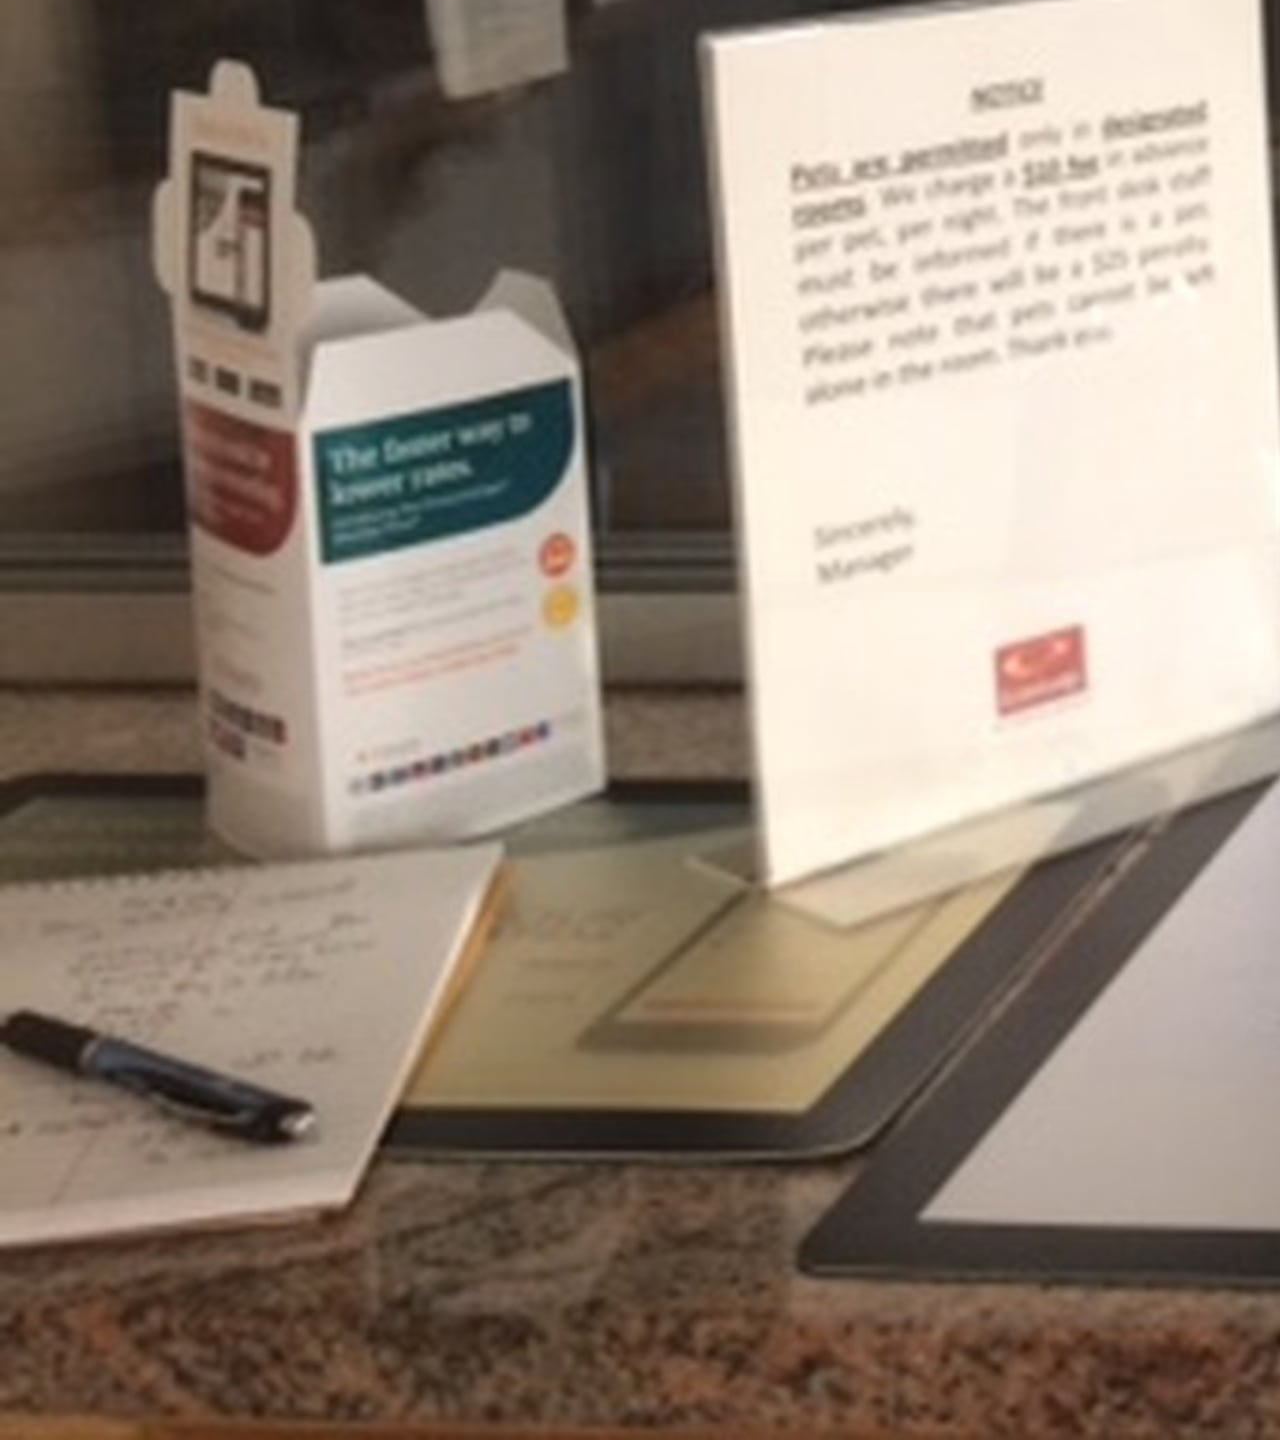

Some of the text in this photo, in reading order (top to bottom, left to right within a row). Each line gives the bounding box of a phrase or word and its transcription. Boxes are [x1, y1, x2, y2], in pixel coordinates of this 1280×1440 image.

[970, 77, 1045, 113] NOTICE
[790, 161, 840, 193] Pets
[852, 154, 889, 182] are
[898, 130, 1010, 175] permitted
[1018, 124, 1062, 150] only
[1100, 97, 1208, 140] designated
[880, 185, 916, 208] We
[924, 170, 995, 200] charge
[1064, 152, 1100, 182] fee
[1132, 135, 1209, 165] advance
[794, 236, 831, 267] per
[896, 220, 933, 246] per
[1012, 196, 1051, 216] The
[1056, 184, 1107, 210] front
[1116, 176, 1161, 201] desk
[1169, 162, 1212, 193] staff
[796, 267, 855, 295] must
[868, 260, 898, 283] be
[912, 235, 1012, 274] informed
[1052, 220, 1108, 247] there
[797, 296, 912, 334] otherwise
[920, 280, 980, 308] there
[989, 267, 1026, 295] will
[1034, 262, 1061, 285] be
[801, 338, 874, 367] Please
[887, 324, 939, 349] note
[952, 311, 997, 338] that
[1010, 299, 1057, 328] pets
[1065, 281, 1137, 314] cannot
[1146, 274, 1172, 297] be
[804, 376, 867, 408] alone
[872, 369, 893, 390] in
[898, 361, 935, 384] the
[1006, 329, 1068, 358] Thank
[327, 444, 380, 473] The
[456, 420, 506, 446] way
[329, 472, 404, 507] lower
[816, 542, 914, 584] Manager
